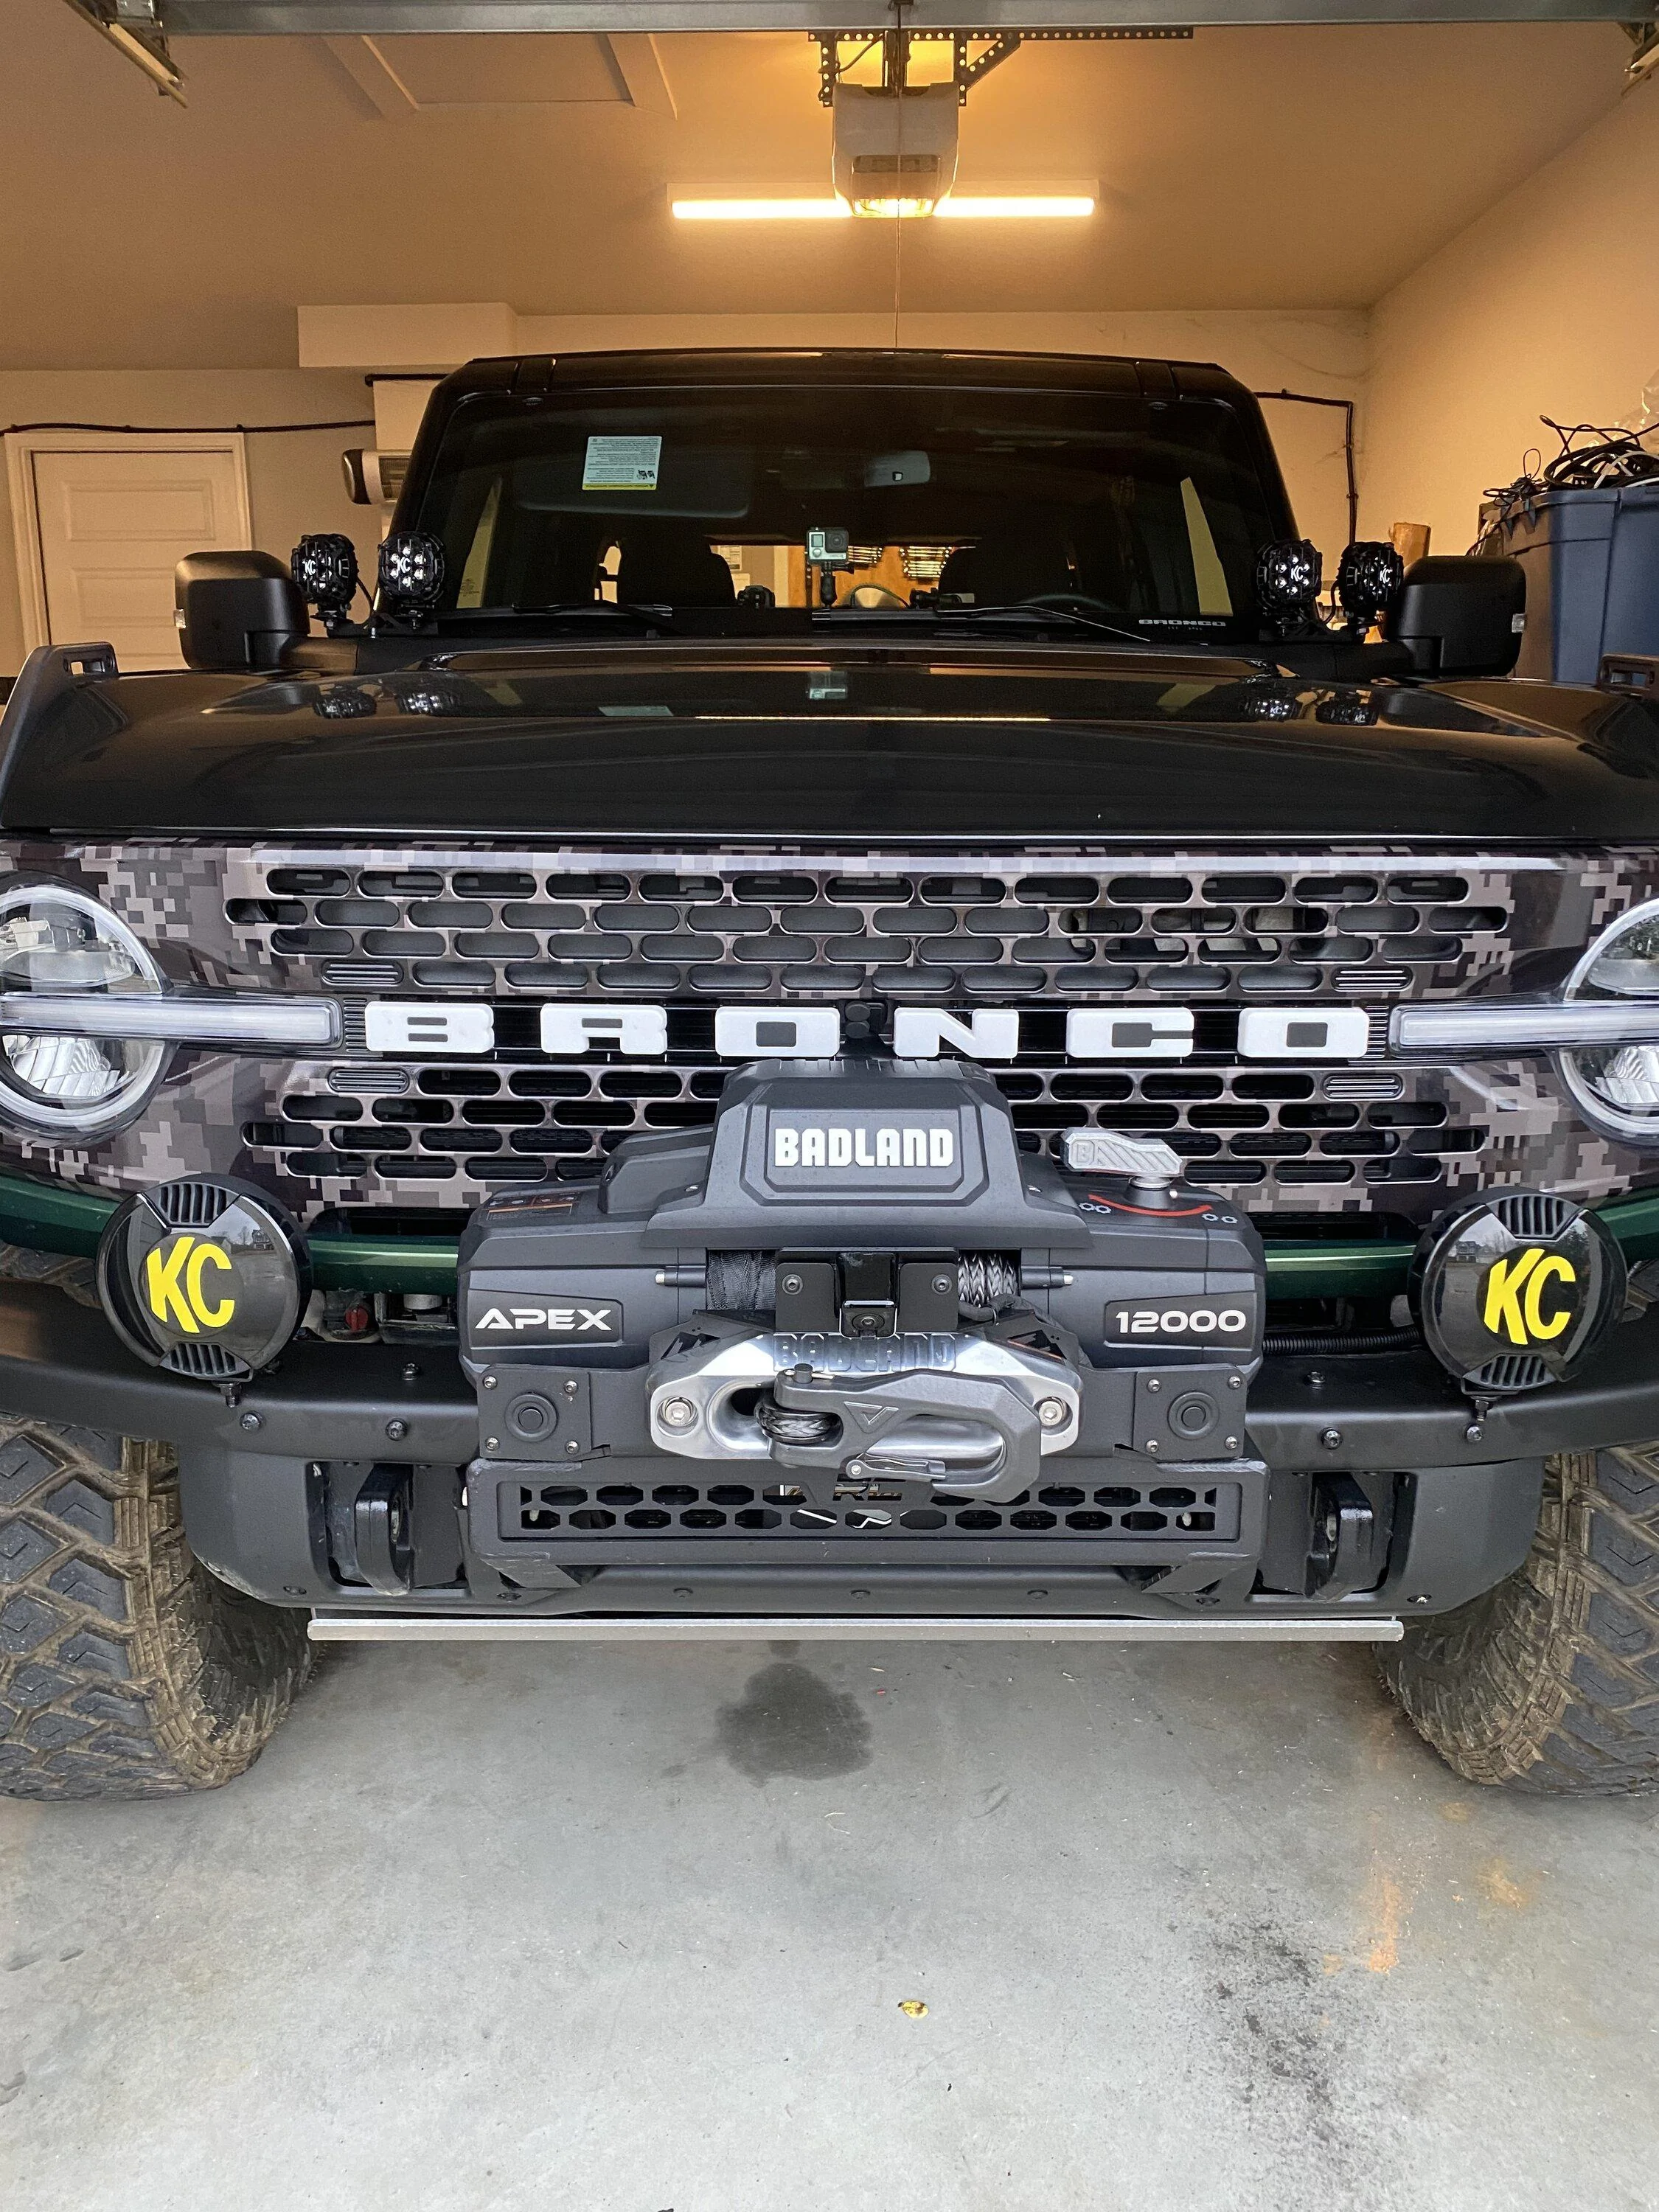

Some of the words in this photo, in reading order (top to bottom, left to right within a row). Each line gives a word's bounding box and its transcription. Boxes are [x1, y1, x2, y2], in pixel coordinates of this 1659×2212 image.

[305, 559, 316, 575] KC
[397, 557, 411, 574] KC
[1291, 566, 1304, 582] KC
[1380, 565, 1393, 582] KC
[364, 1001, 1371, 1060] BRONCO
[775, 1127, 953, 1167] BADLAND
[147, 1237, 235, 1333] KC
[1484, 1248, 1576, 1345] KC
[475, 1307, 612, 1331] APEX
[1116, 1310, 1246, 1333] 12000
